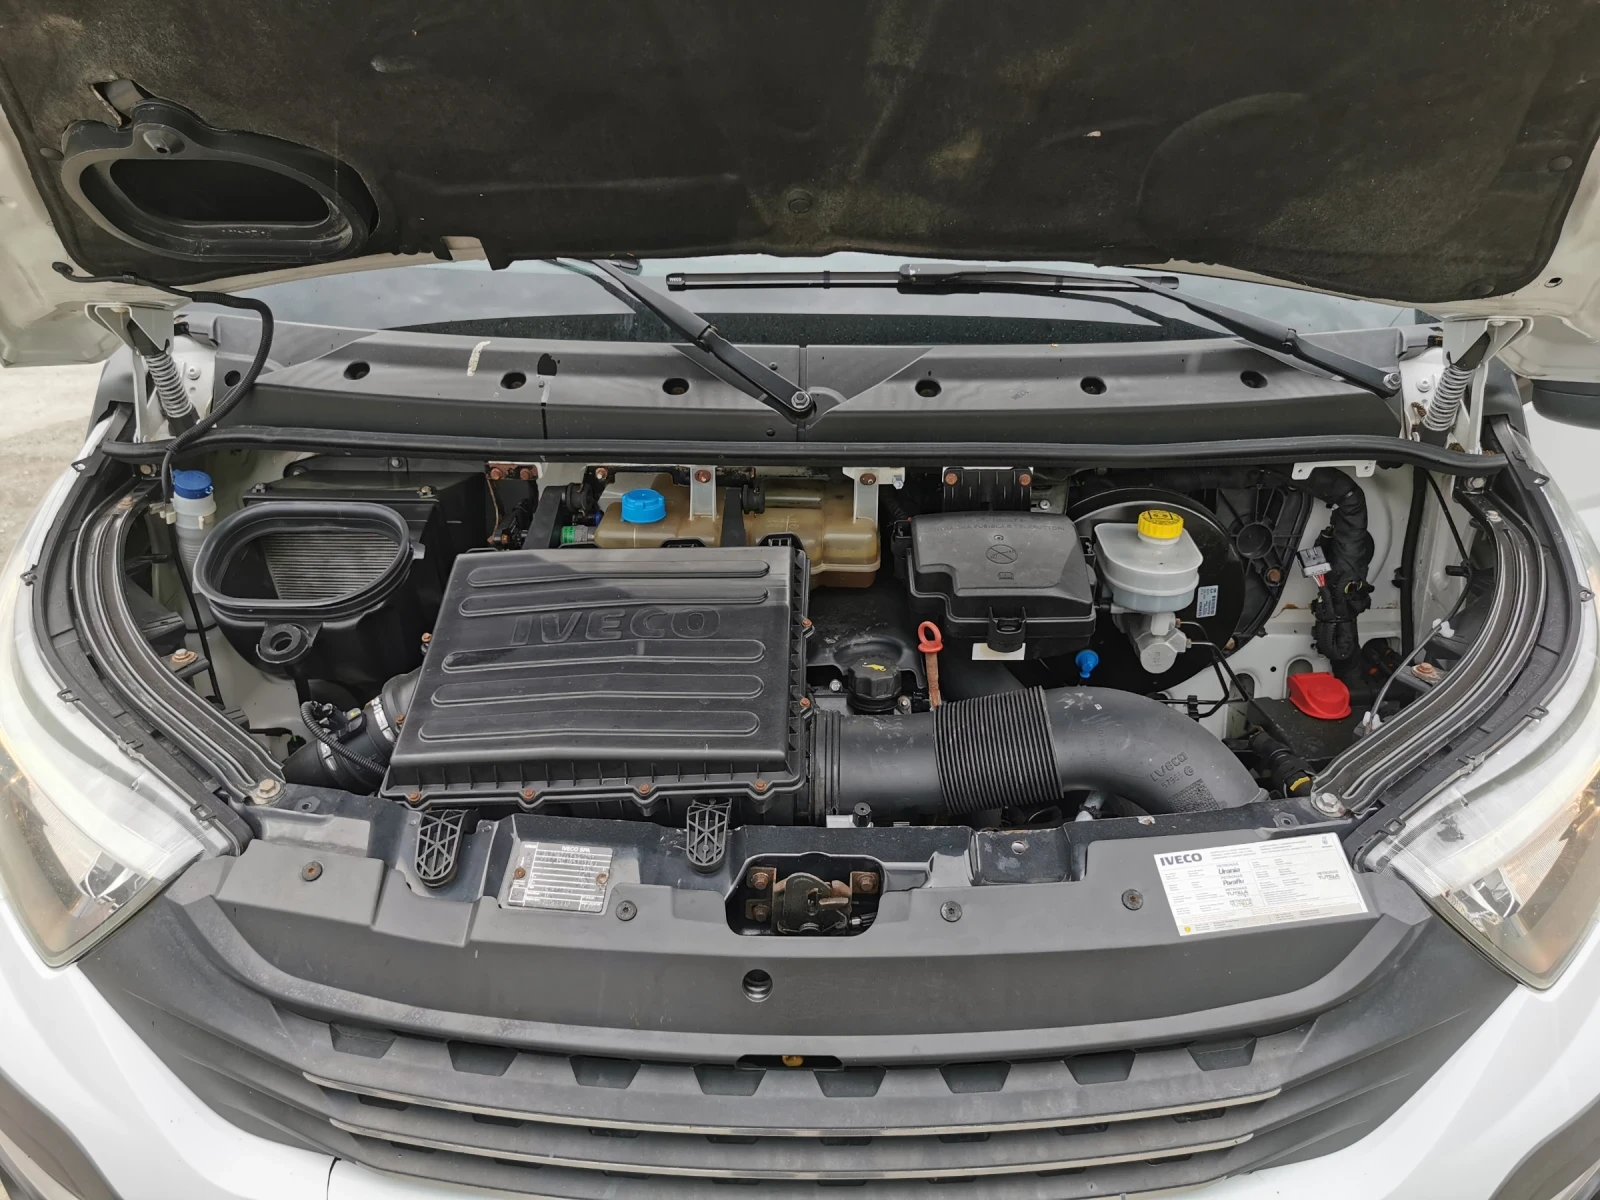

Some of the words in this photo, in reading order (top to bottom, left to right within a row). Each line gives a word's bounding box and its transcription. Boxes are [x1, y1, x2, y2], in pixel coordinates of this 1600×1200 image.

[510, 606, 721, 647] IVECO
[1149, 751, 1189, 782] IVECO
[1159, 852, 1203, 867] IVECO
[1218, 867, 1241, 875] Urania
[1222, 878, 1245, 886] Paraflu
